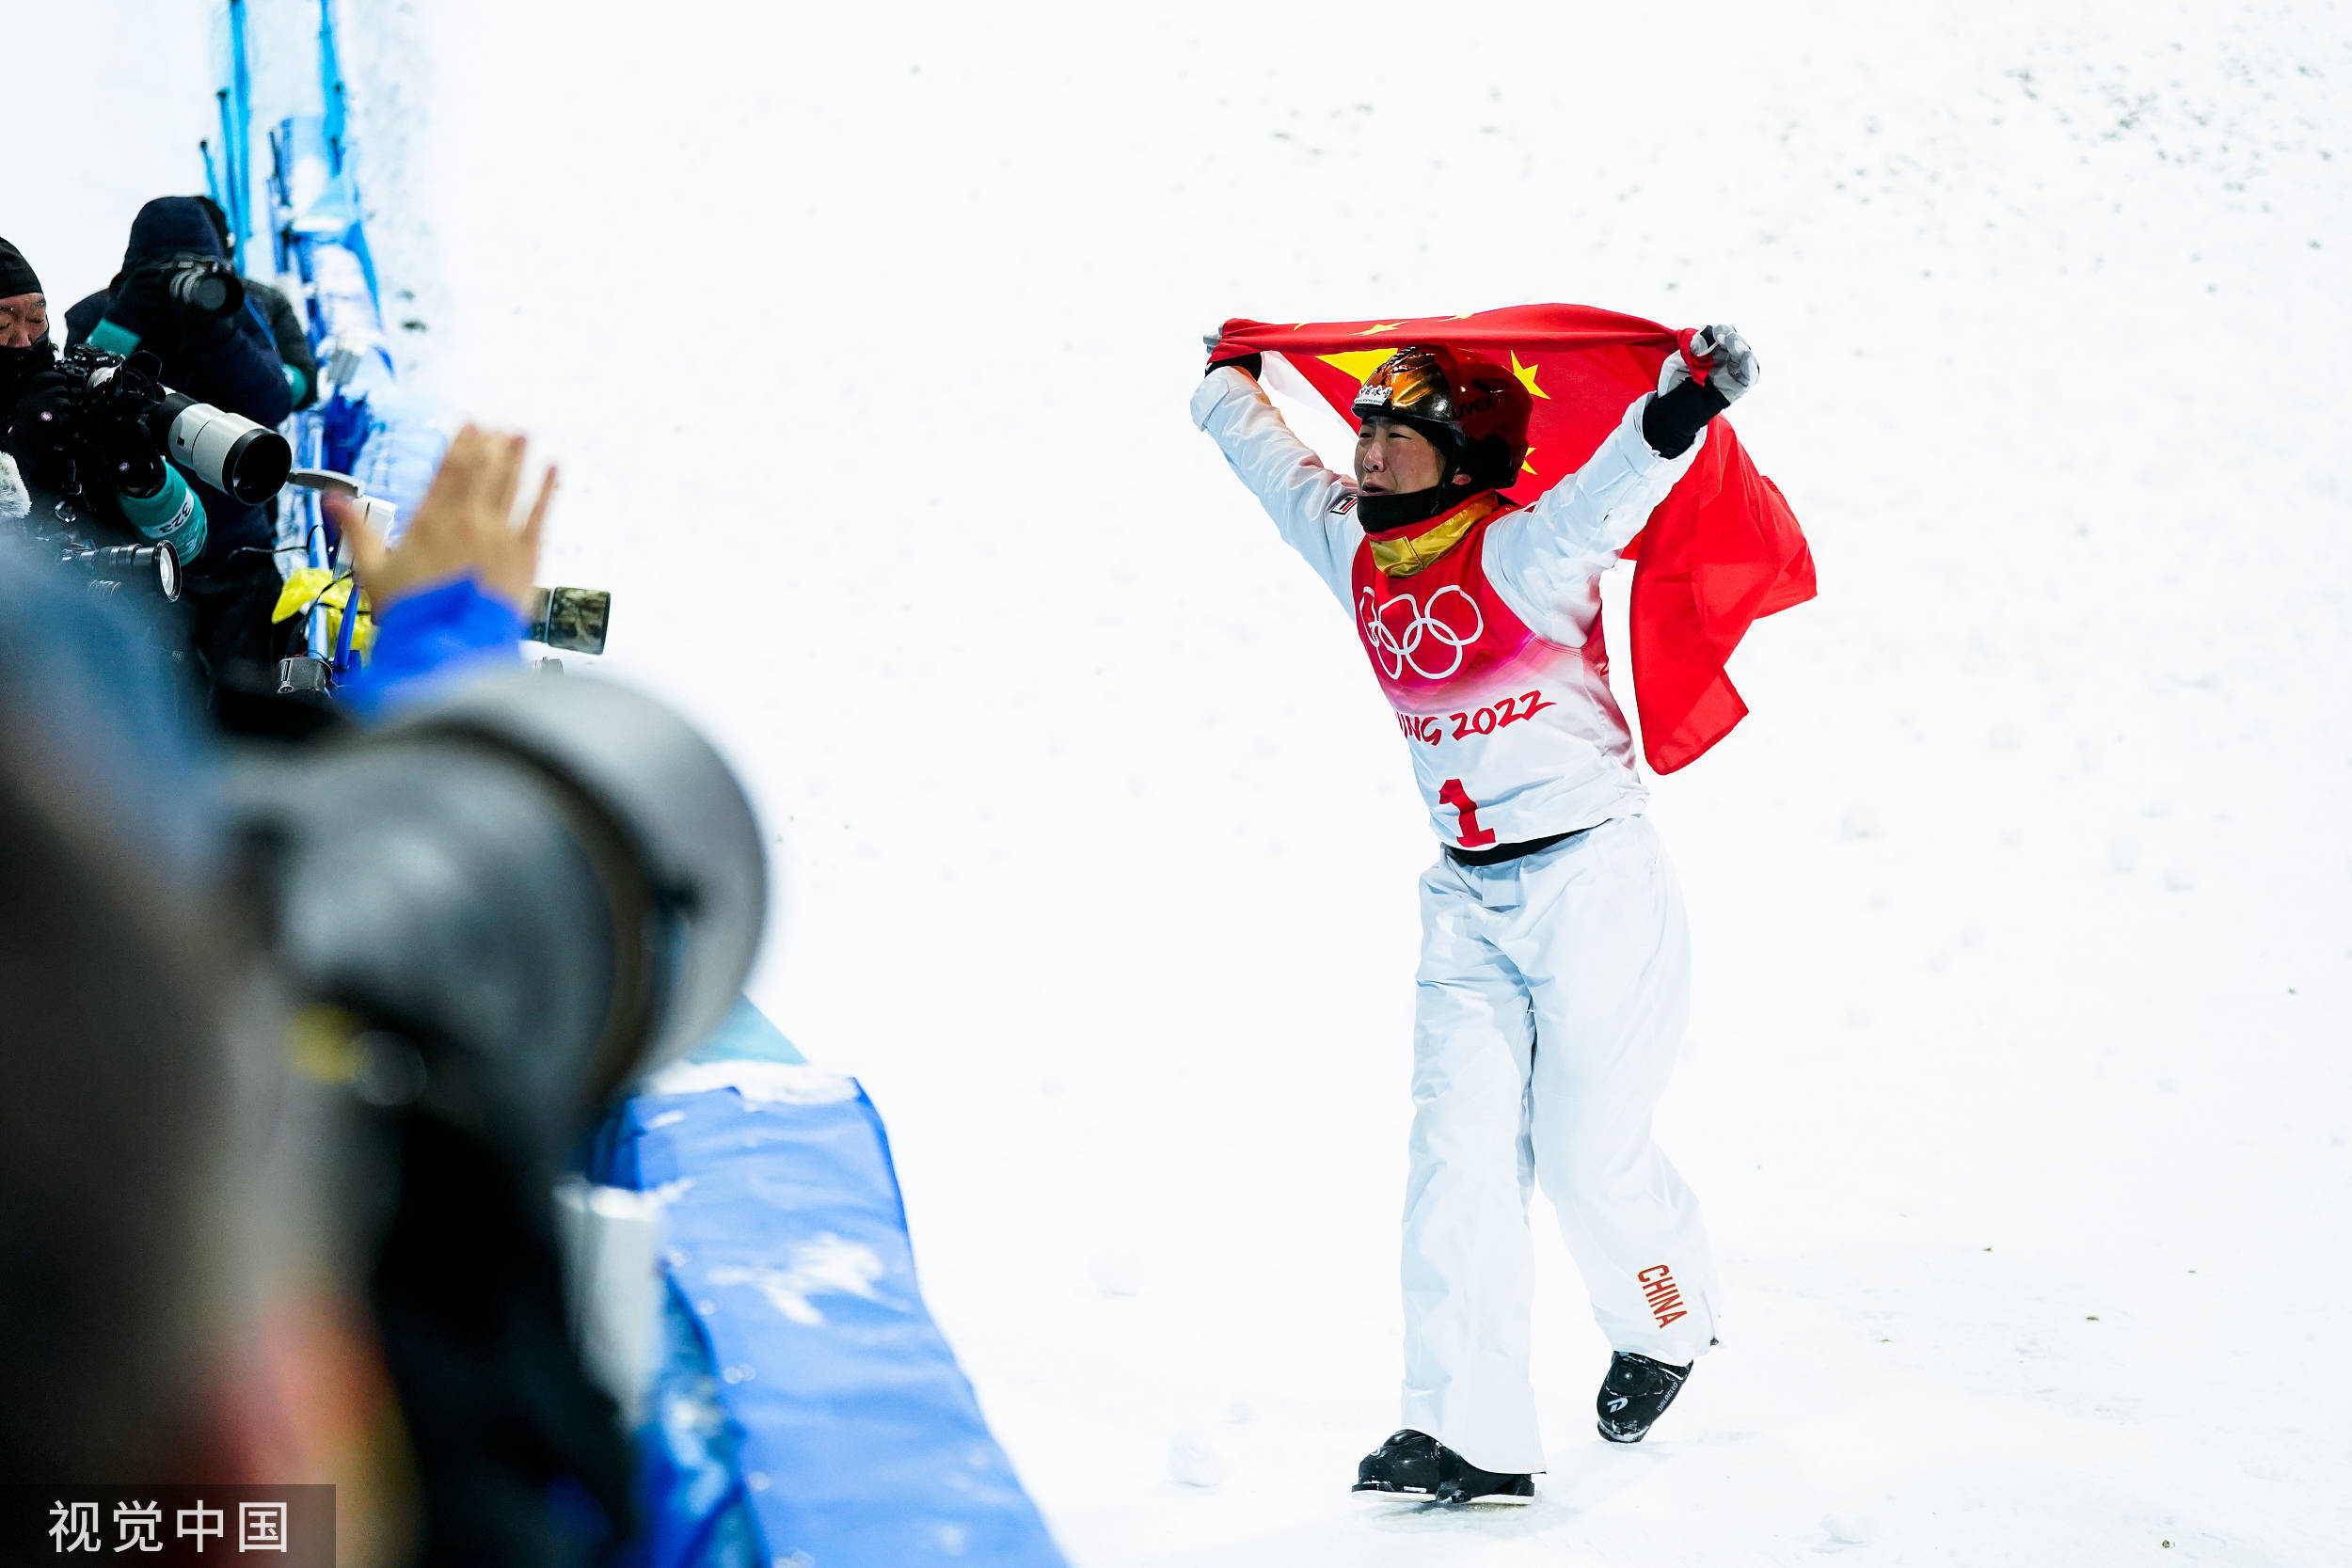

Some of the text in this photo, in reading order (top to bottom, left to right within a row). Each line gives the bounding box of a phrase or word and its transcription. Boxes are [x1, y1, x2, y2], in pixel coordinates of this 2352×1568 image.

[1451, 397, 1496, 420] uvex
[1449, 689, 1558, 741] 2022
[1438, 778, 1496, 848] 1
[1637, 1264, 1689, 1329] CHINA
